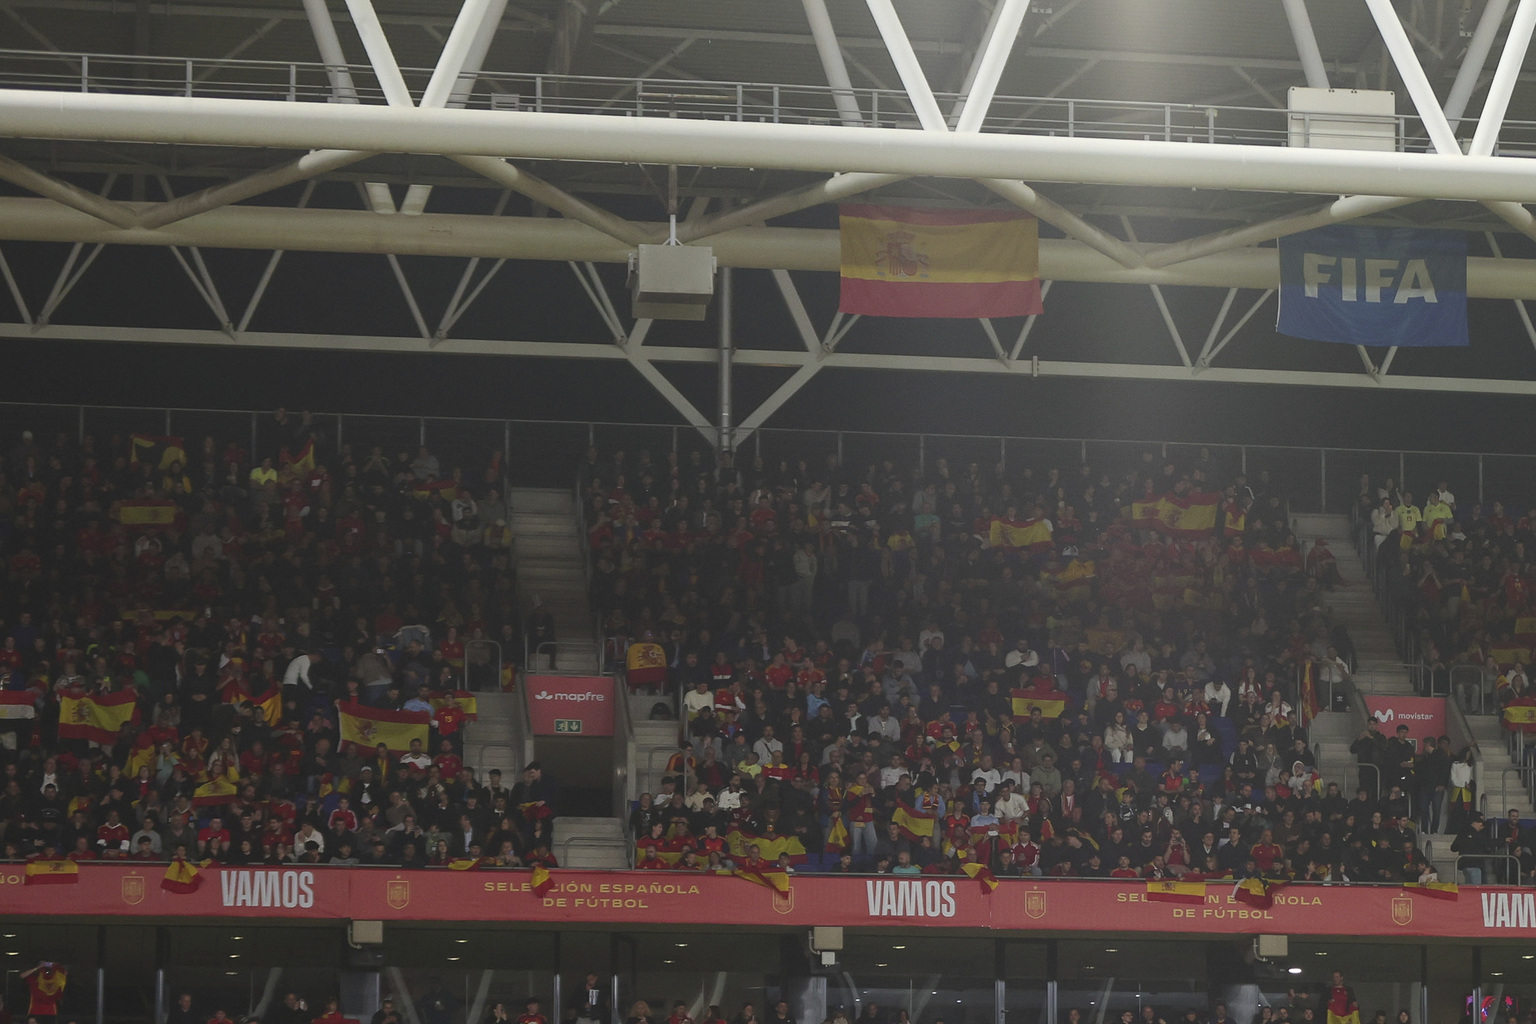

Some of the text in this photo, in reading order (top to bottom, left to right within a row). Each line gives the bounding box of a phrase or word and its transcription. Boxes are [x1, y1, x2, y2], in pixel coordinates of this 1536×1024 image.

[1303, 253, 1438, 304] FIFA
[554, 691, 605, 702] mapfre
[1398, 709, 1434, 719] movistar
[221, 870, 314, 908] VAMOS
[484, 881, 700, 895] SELEIÓN ESPAÑOLA
[543, 895, 649, 909] DE FÚTBOL
[866, 880, 956, 917] VAMOS
[1227, 893, 1322, 906] EÑOLA
[1173, 906, 1273, 919] DE FÚTBOL
